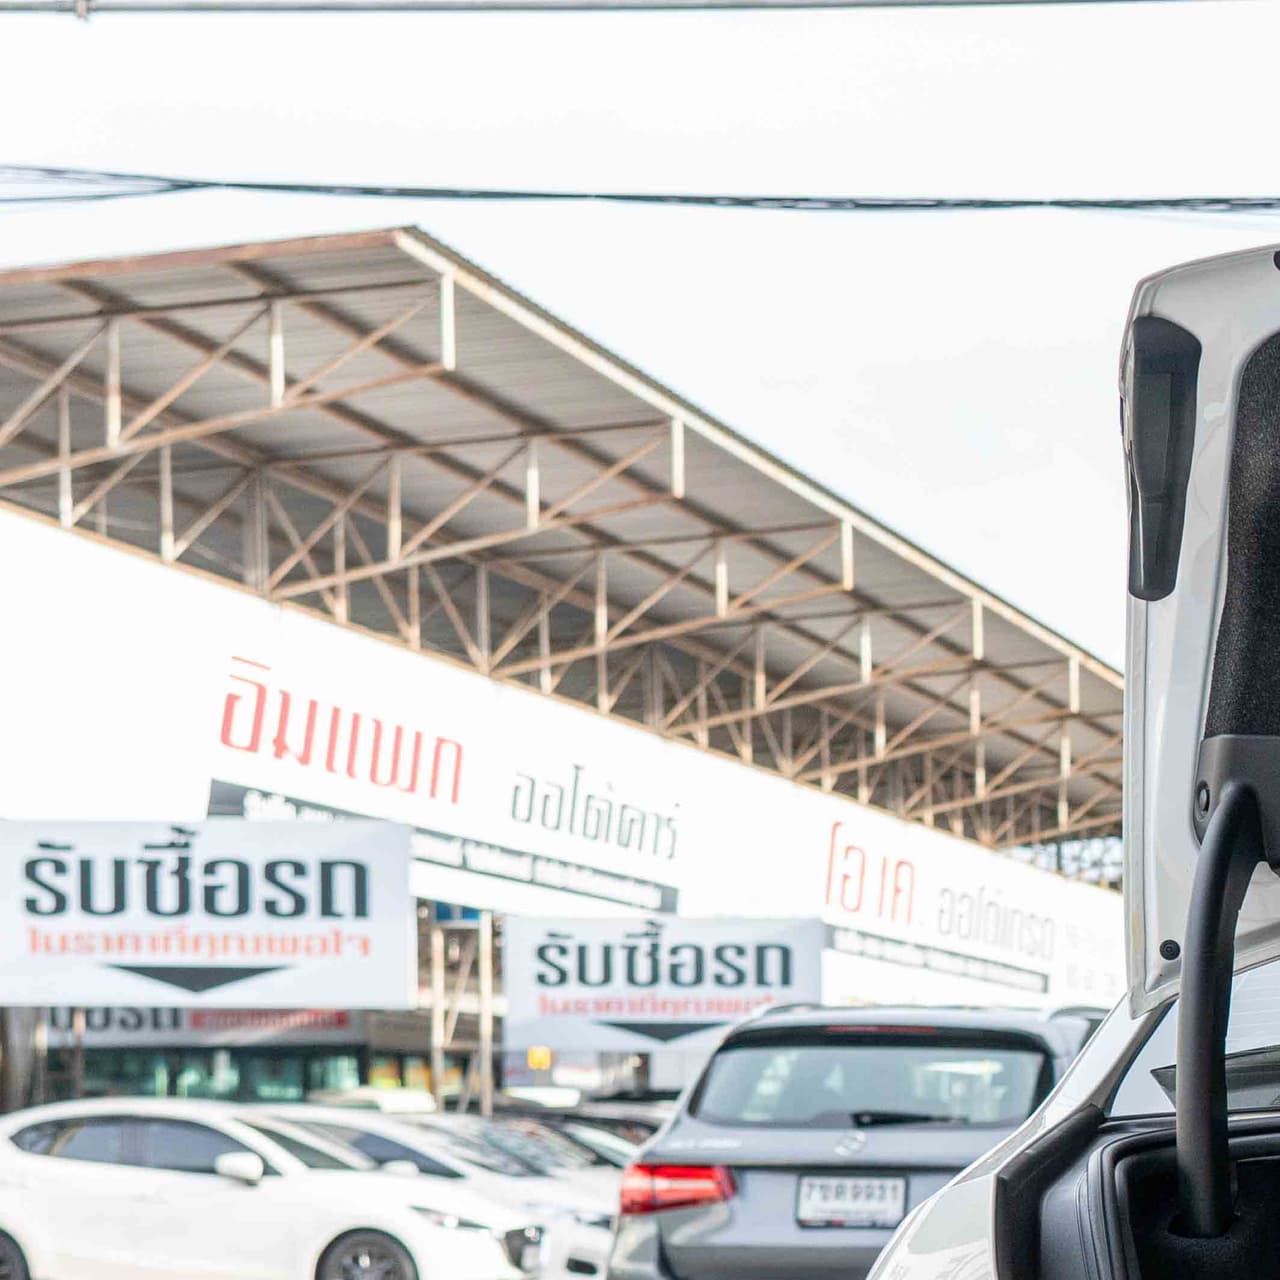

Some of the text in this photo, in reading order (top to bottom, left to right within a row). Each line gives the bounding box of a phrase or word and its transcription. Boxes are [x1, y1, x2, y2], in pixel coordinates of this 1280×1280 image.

[25, 826, 370, 918] รับซื้อรถ
[536, 920, 794, 987] รับซื้อรถ
